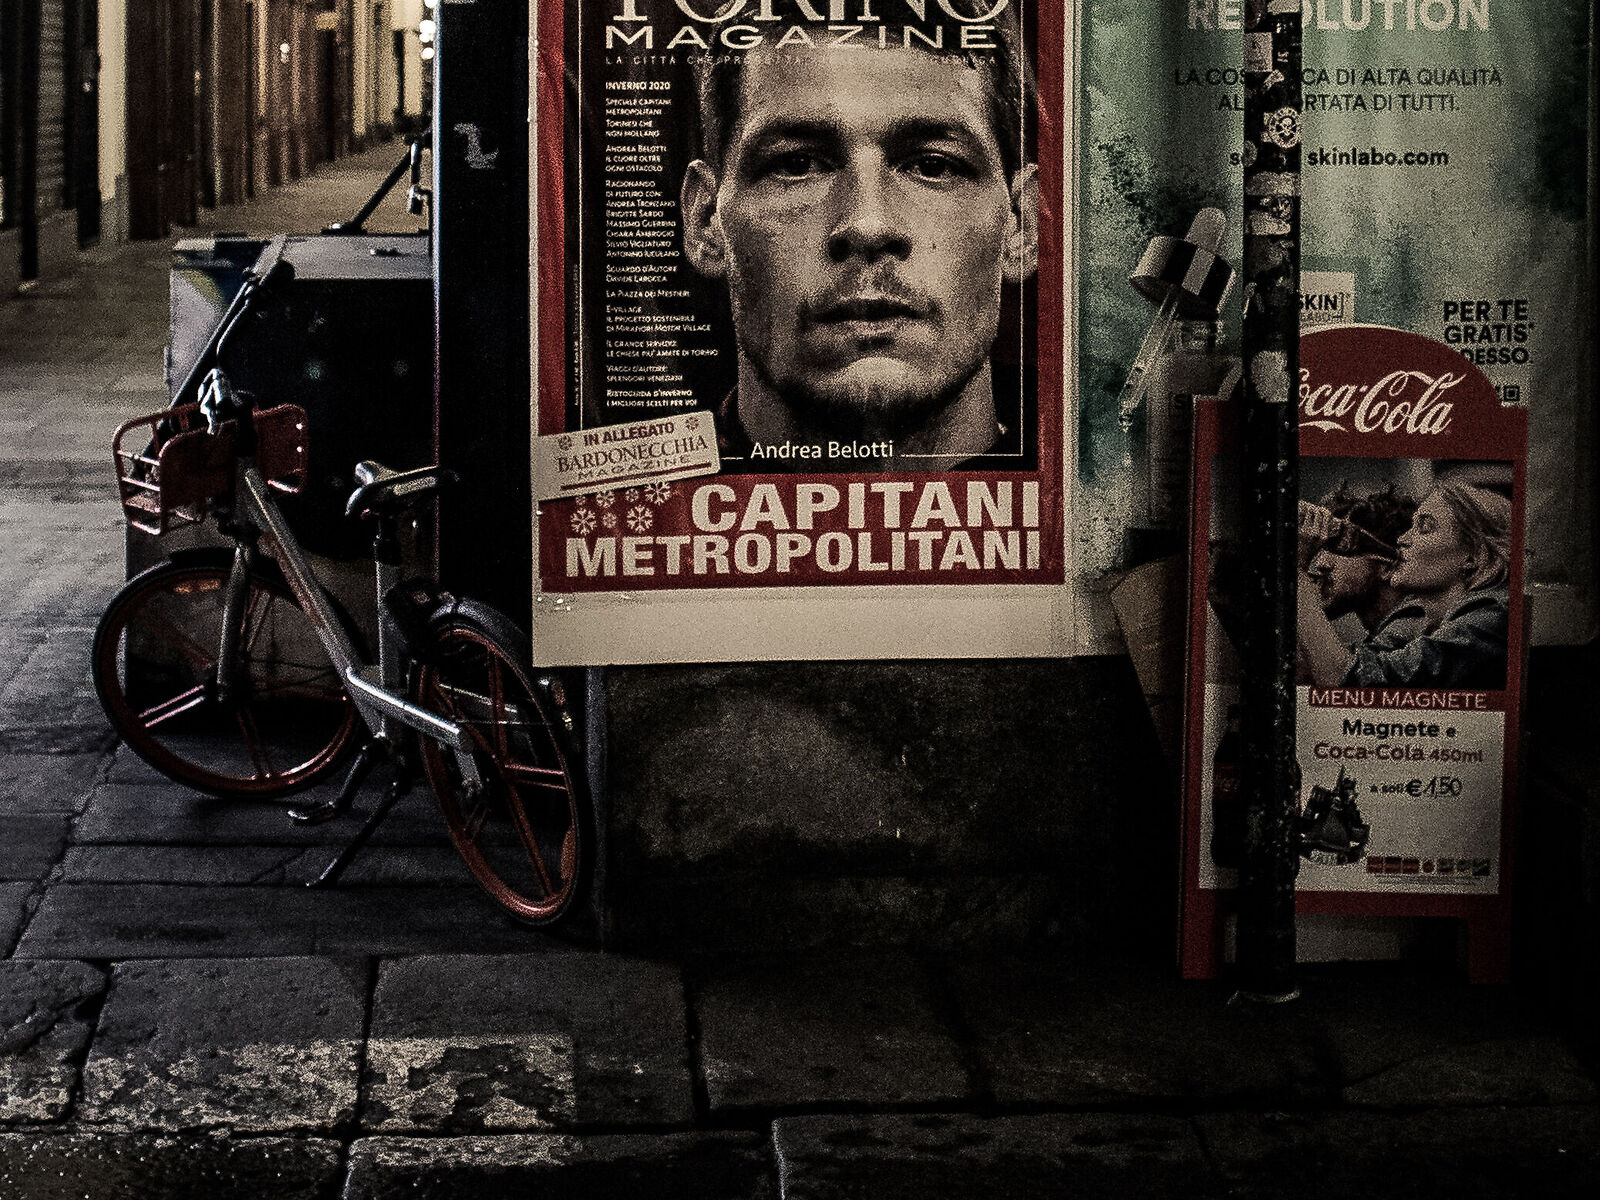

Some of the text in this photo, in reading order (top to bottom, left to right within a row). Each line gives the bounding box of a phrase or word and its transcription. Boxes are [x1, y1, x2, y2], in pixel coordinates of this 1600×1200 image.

[605, 25, 998, 50] MAGAZINE
[605, 56, 622, 65] LA
[605, 81, 671, 91] INVERNO 2020
[1174, 65, 1502, 87] LA COSCA DI ALTA QUALITÀ
[1374, 94, 1392, 111] DI
[1400, 94, 1460, 111] TUTTI.
[1307, 148, 1450, 167] skinlabo.com
[1443, 299, 1529, 322] PER TE
[1459, 348, 1534, 366] DESSO.
[583, 422, 675, 447] IN ALLEGATO
[556, 434, 709, 473] BARDONECCHIA
[750, 439, 894, 459] Andrea Belotti
[692, 480, 1041, 532] CAPITANI
[565, 530, 1041, 578] METROPOLITANI
[1311, 688, 1488, 709] MENU MAGNETE
[1342, 719, 1441, 740] Magnete
